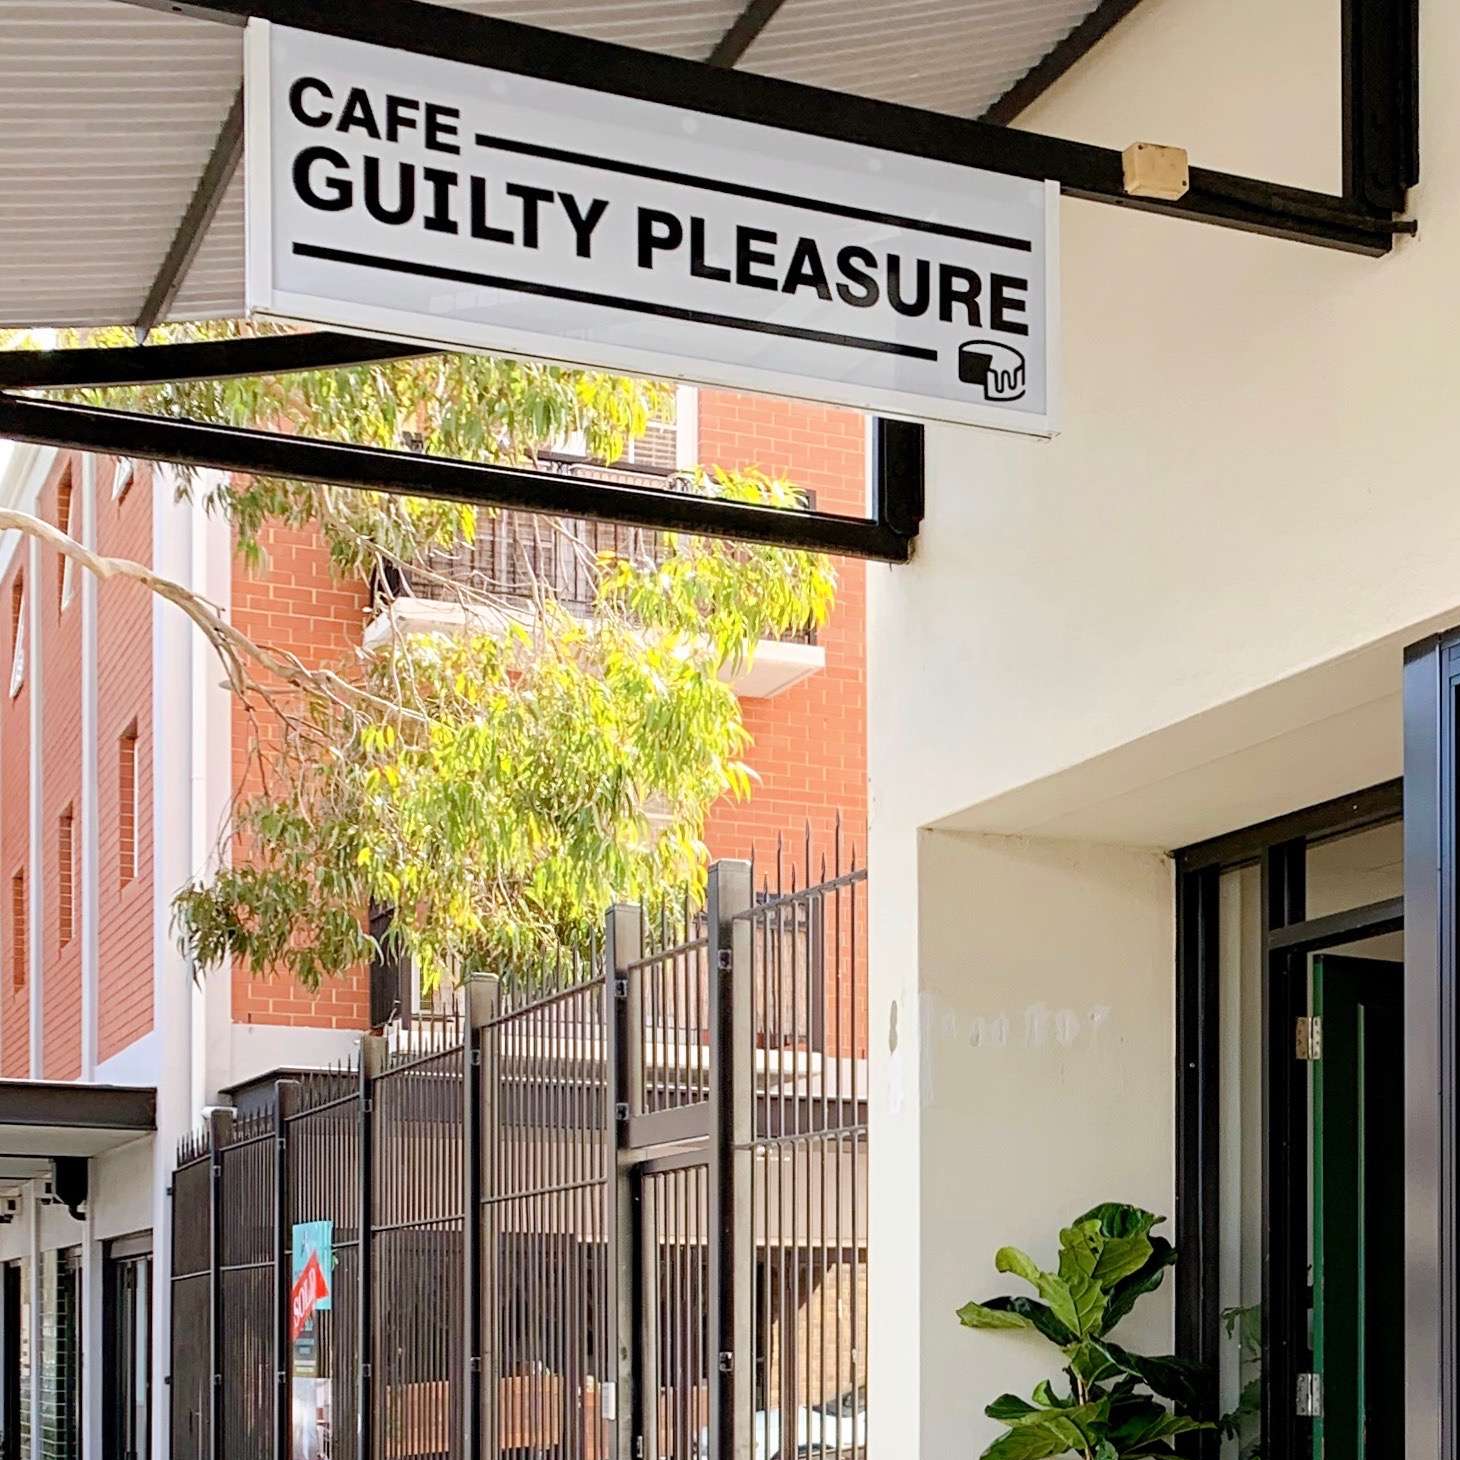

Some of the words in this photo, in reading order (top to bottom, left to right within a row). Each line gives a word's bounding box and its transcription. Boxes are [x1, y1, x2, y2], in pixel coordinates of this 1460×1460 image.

[289, 77, 461, 156] CAFE
[292, 146, 609, 259] GUILTY
[637, 206, 1029, 337] PLEASURE
[293, 1267, 316, 1329] SOLD
